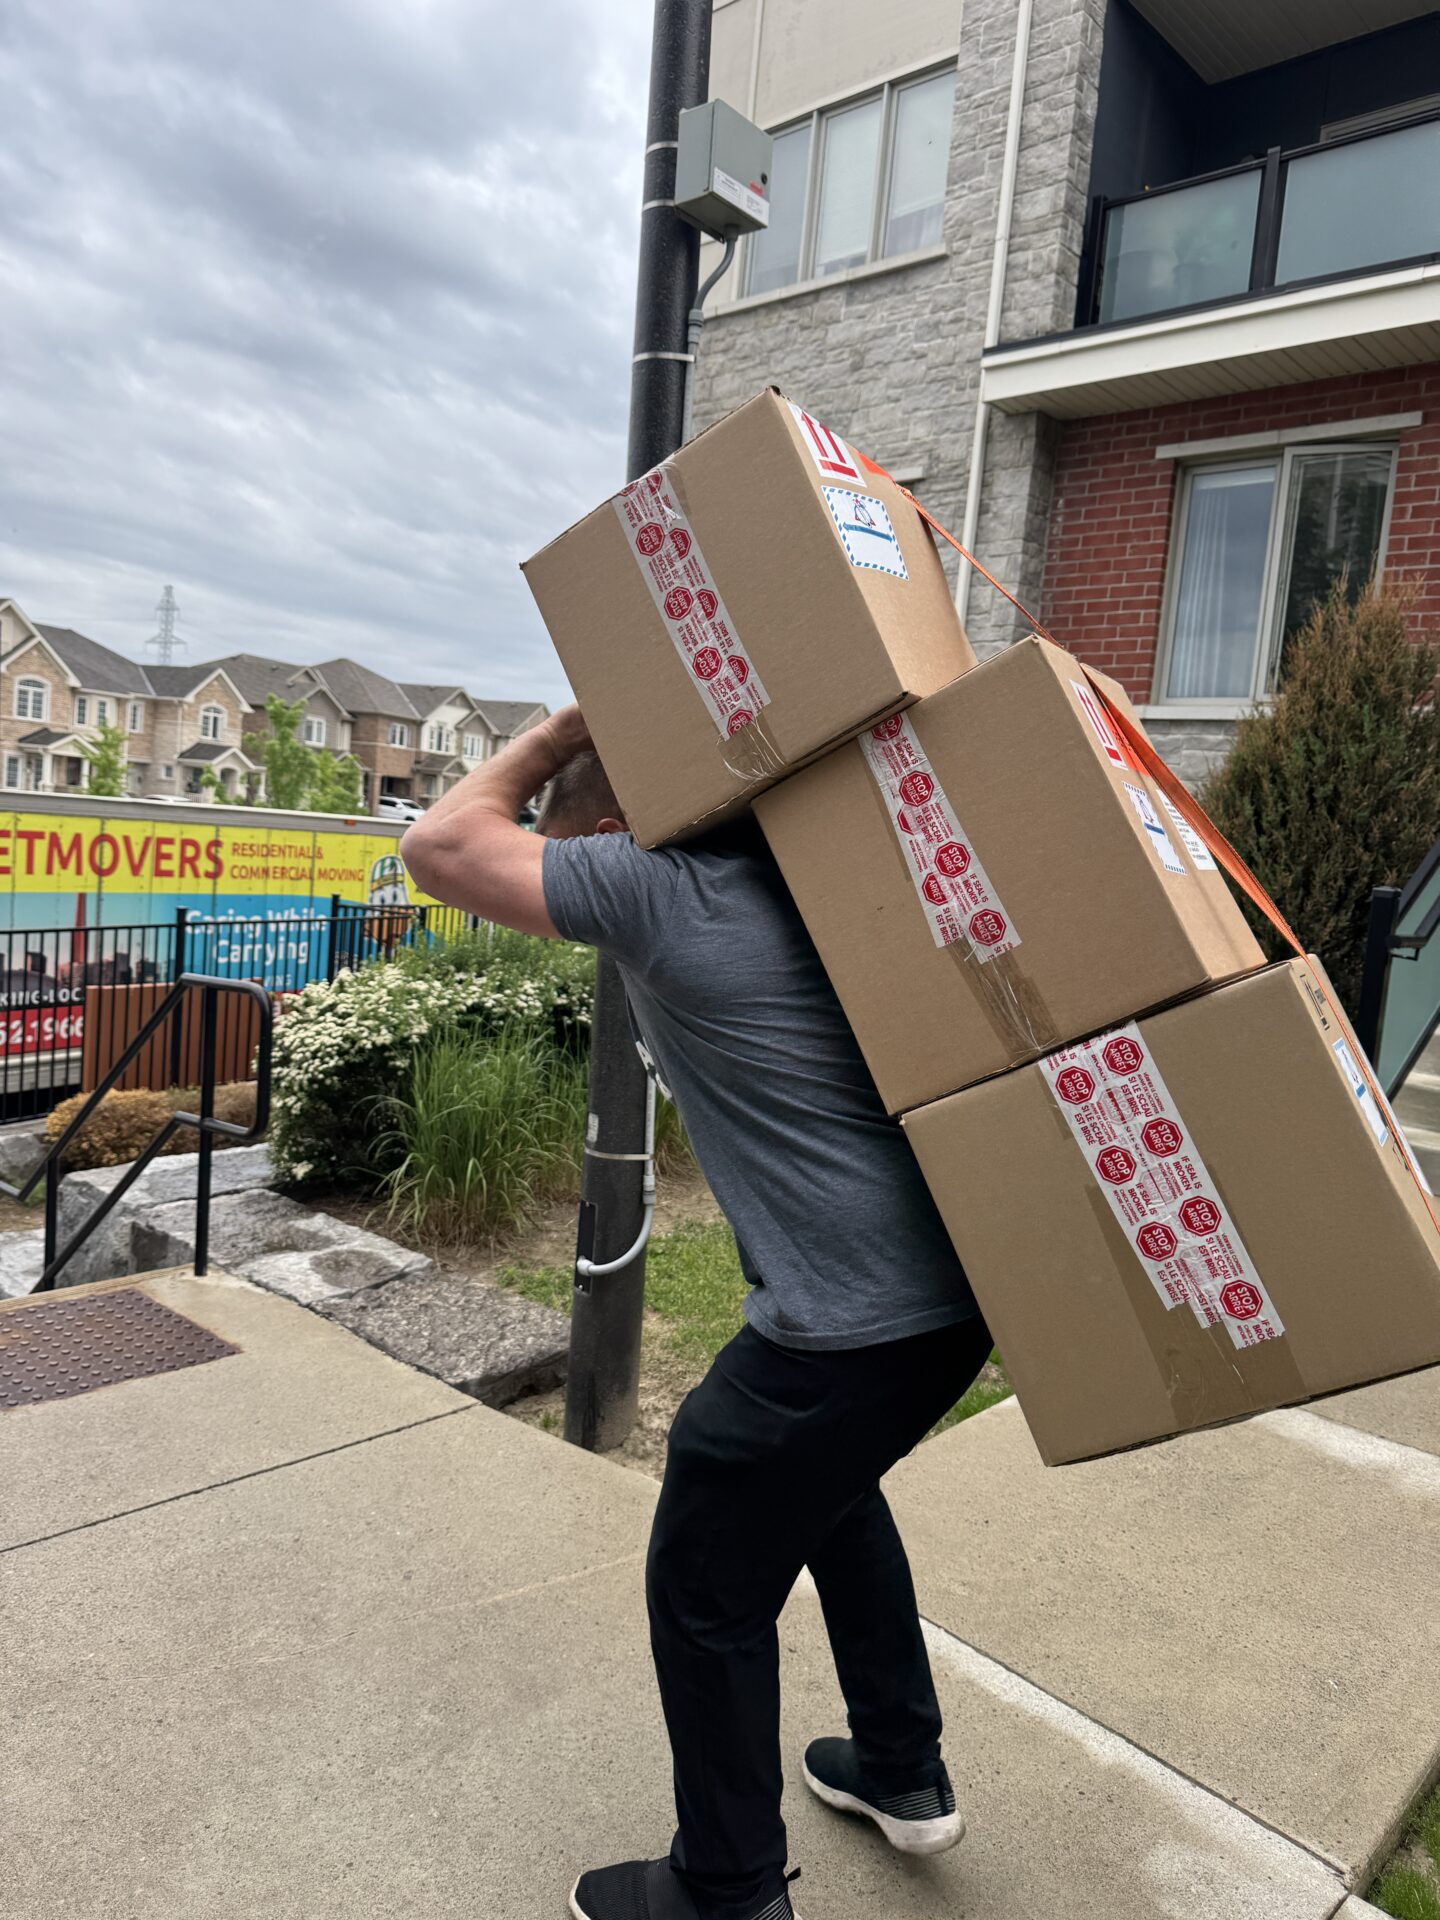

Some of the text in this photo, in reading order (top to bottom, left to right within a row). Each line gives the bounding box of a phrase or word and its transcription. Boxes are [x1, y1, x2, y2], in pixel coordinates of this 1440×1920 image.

[639, 531, 654, 551] STOP
[667, 595, 683, 616] STOP
[696, 655, 711, 676] STOP
[912, 775, 929, 797] STOP
[915, 815, 925, 826] EST
[924, 813, 933, 822] LE
[929, 821, 944, 843] SCEAU
[231, 842, 313, 859] RESIDENTIAL
[947, 846, 965, 869] STOP
[230, 865, 365, 882] COMMERCIAL MOVING
[962, 878, 979, 905] BROKEN
[972, 880, 985, 896] SEAL
[185, 908, 327, 938] Caring While
[934, 914, 944, 925] EST
[944, 914, 954, 923] LE
[982, 914, 1000, 937] STOP
[212, 936, 309, 966] Carrying
[1118, 1042, 1138, 1066] STOP
[1070, 1072, 1090, 1095] STOP
[1119, 1084, 1131, 1096] EST
[1127, 1076, 1154, 1117] SI LE SCEAU
[1074, 1113, 1085, 1125] EST
[1084, 1112, 1094, 1121] LE
[1089, 1121, 1107, 1145] SCEAU
[1156, 1123, 1176, 1148] STOP
[1110, 1151, 1130, 1176] STOP
[1180, 1155, 1202, 1189] IF SEAL IS
[1171, 1161, 1192, 1190] BROKEN
[1127, 1188, 1147, 1217] BROKEN
[1139, 1190, 1152, 1206] SEAL
[1148, 1207, 1157, 1215] IS
[1195, 1202, 1215, 1227] STOP
[1151, 1227, 1171, 1252] STOP
[1205, 1236, 1214, 1244] SI
[1209, 1245, 1219, 1254] LE
[1197, 1245, 1210, 1258] EST
[1157, 1270, 1168, 1282] EST
[1163, 1261, 1173, 1269] SI
[1167, 1269, 1178, 1279] LE
[1213, 1254, 1232, 1280] SCEAU
[1196, 1294, 1208, 1306] EST
[1236, 1286, 1256, 1311] STOP
[1261, 1319, 1270, 1327] IF
